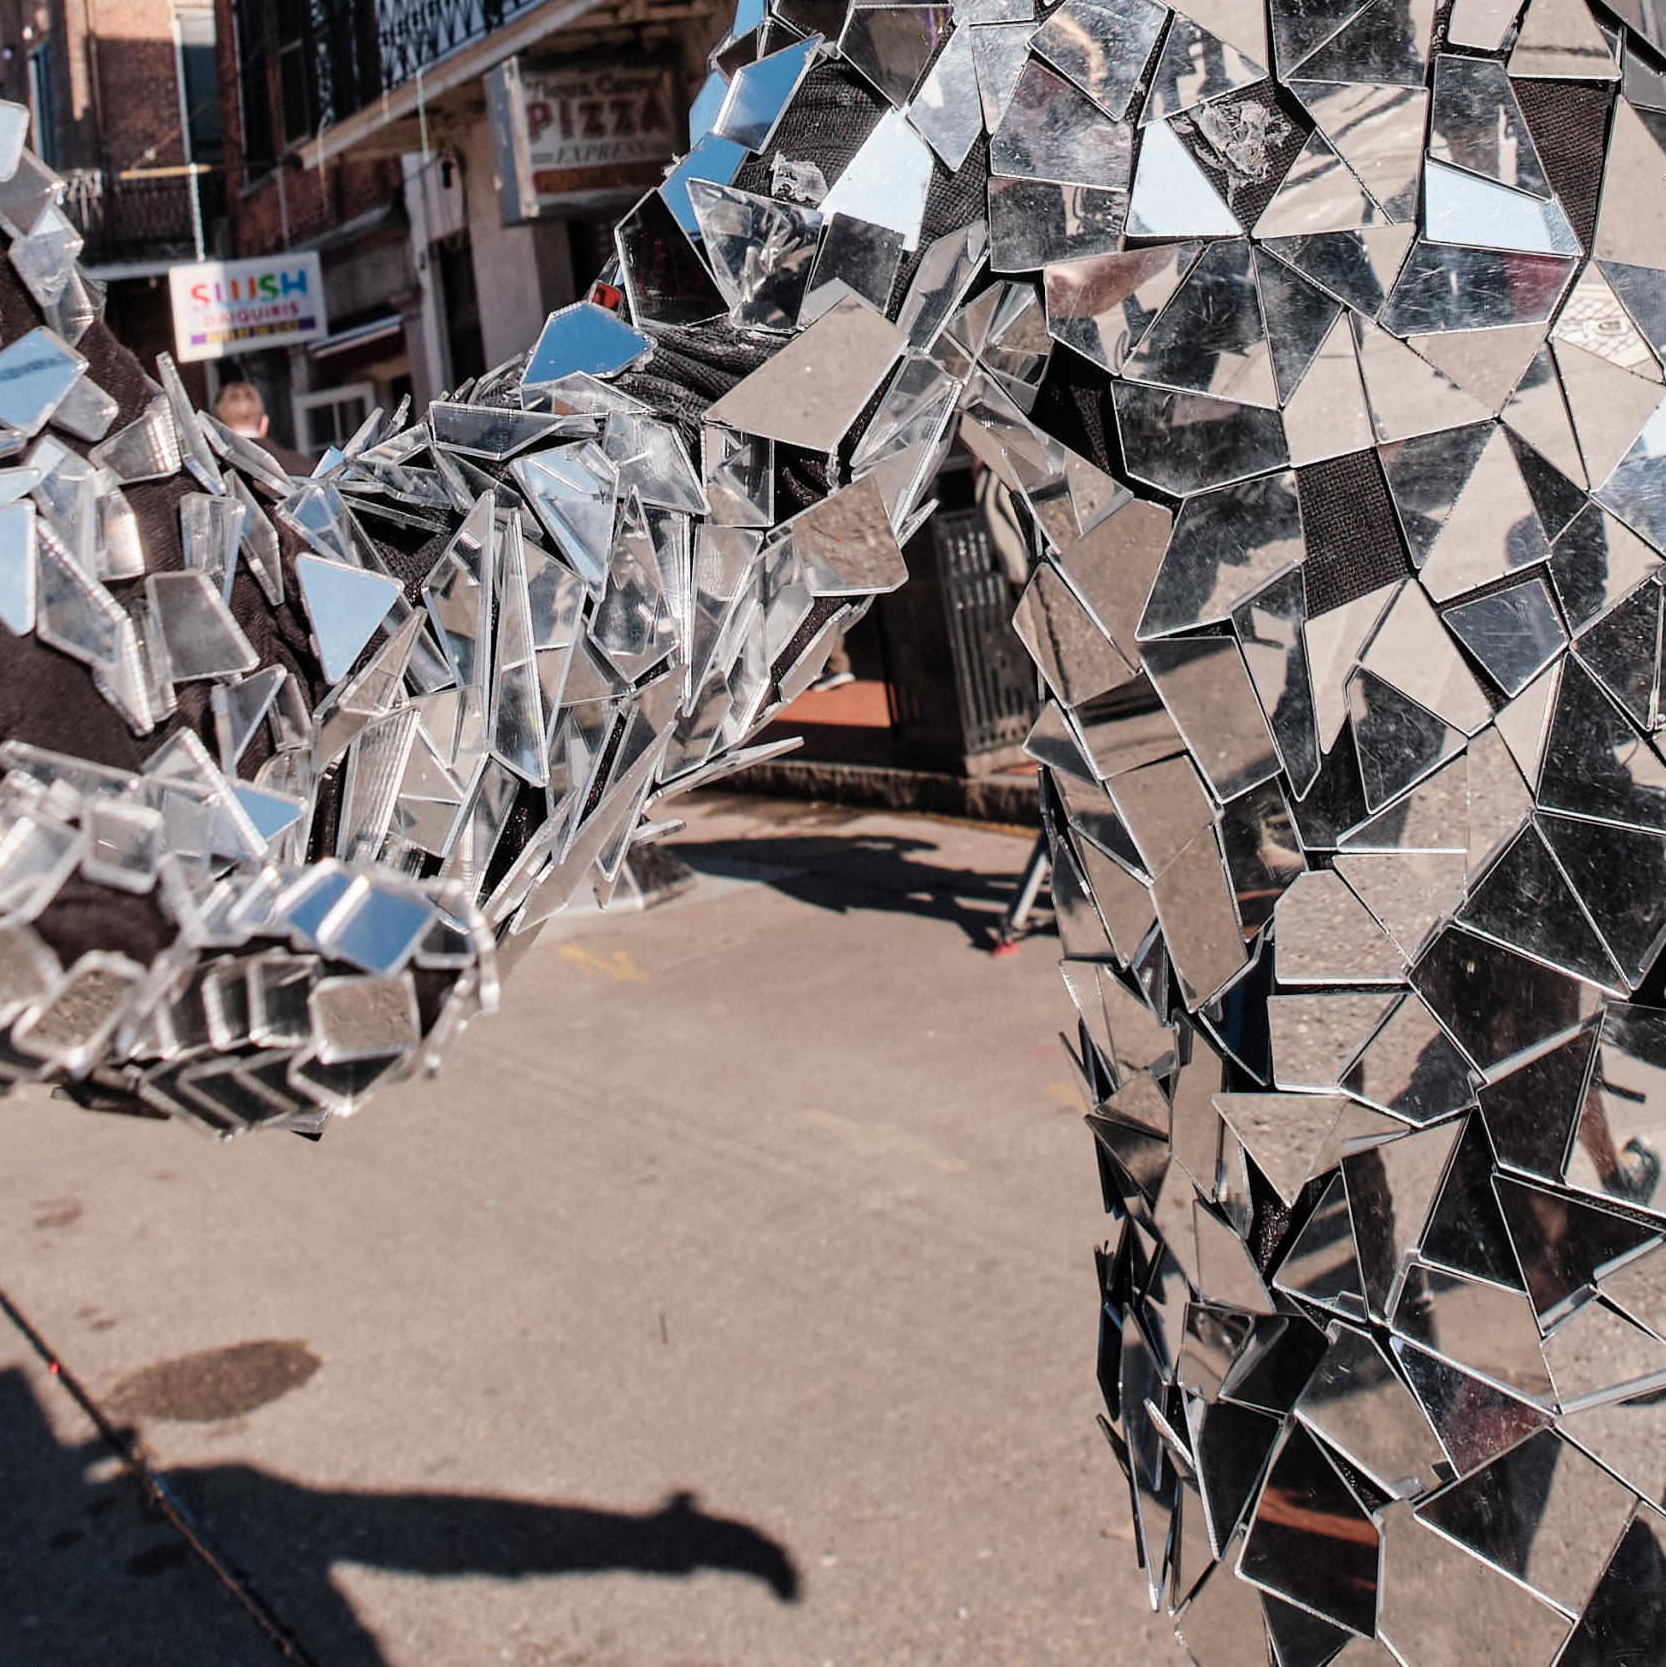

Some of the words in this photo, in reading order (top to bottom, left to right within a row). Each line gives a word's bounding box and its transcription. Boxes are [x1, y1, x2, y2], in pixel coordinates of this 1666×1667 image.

[527, 94, 671, 143] PIZZA
[556, 141, 646, 164] EXPRESS
[189, 268, 308, 307] SLUSH
[203, 302, 300, 327] DAIQUIRIS
